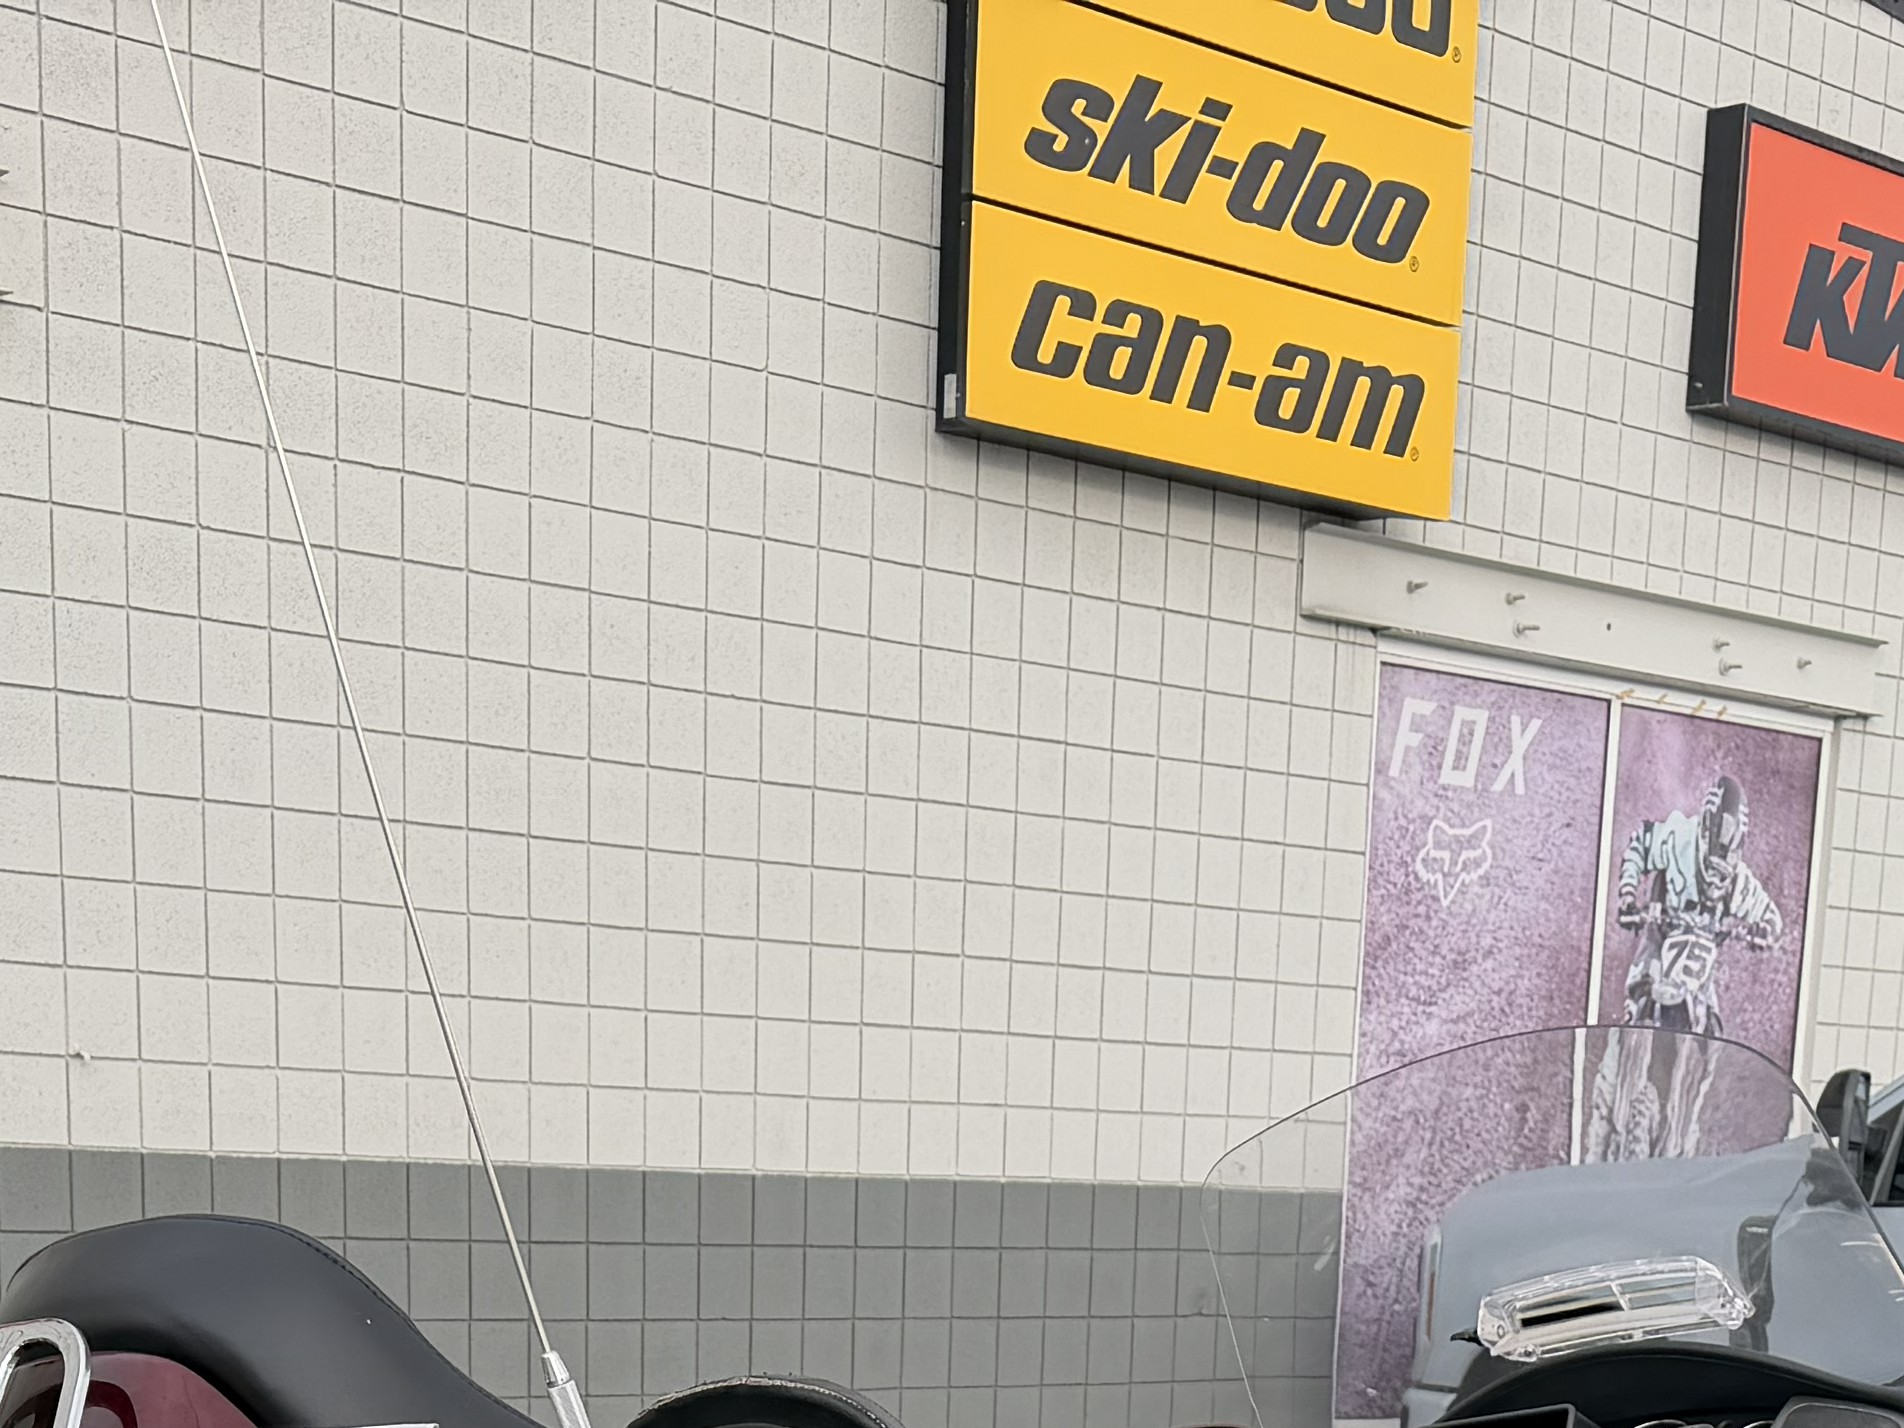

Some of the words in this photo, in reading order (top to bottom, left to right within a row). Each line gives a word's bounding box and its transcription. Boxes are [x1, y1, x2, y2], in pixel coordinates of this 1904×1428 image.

[1024, 74, 1430, 264] ski-doo
[1010, 279, 1426, 458] can-am
[1388, 697, 1544, 795] FOX
